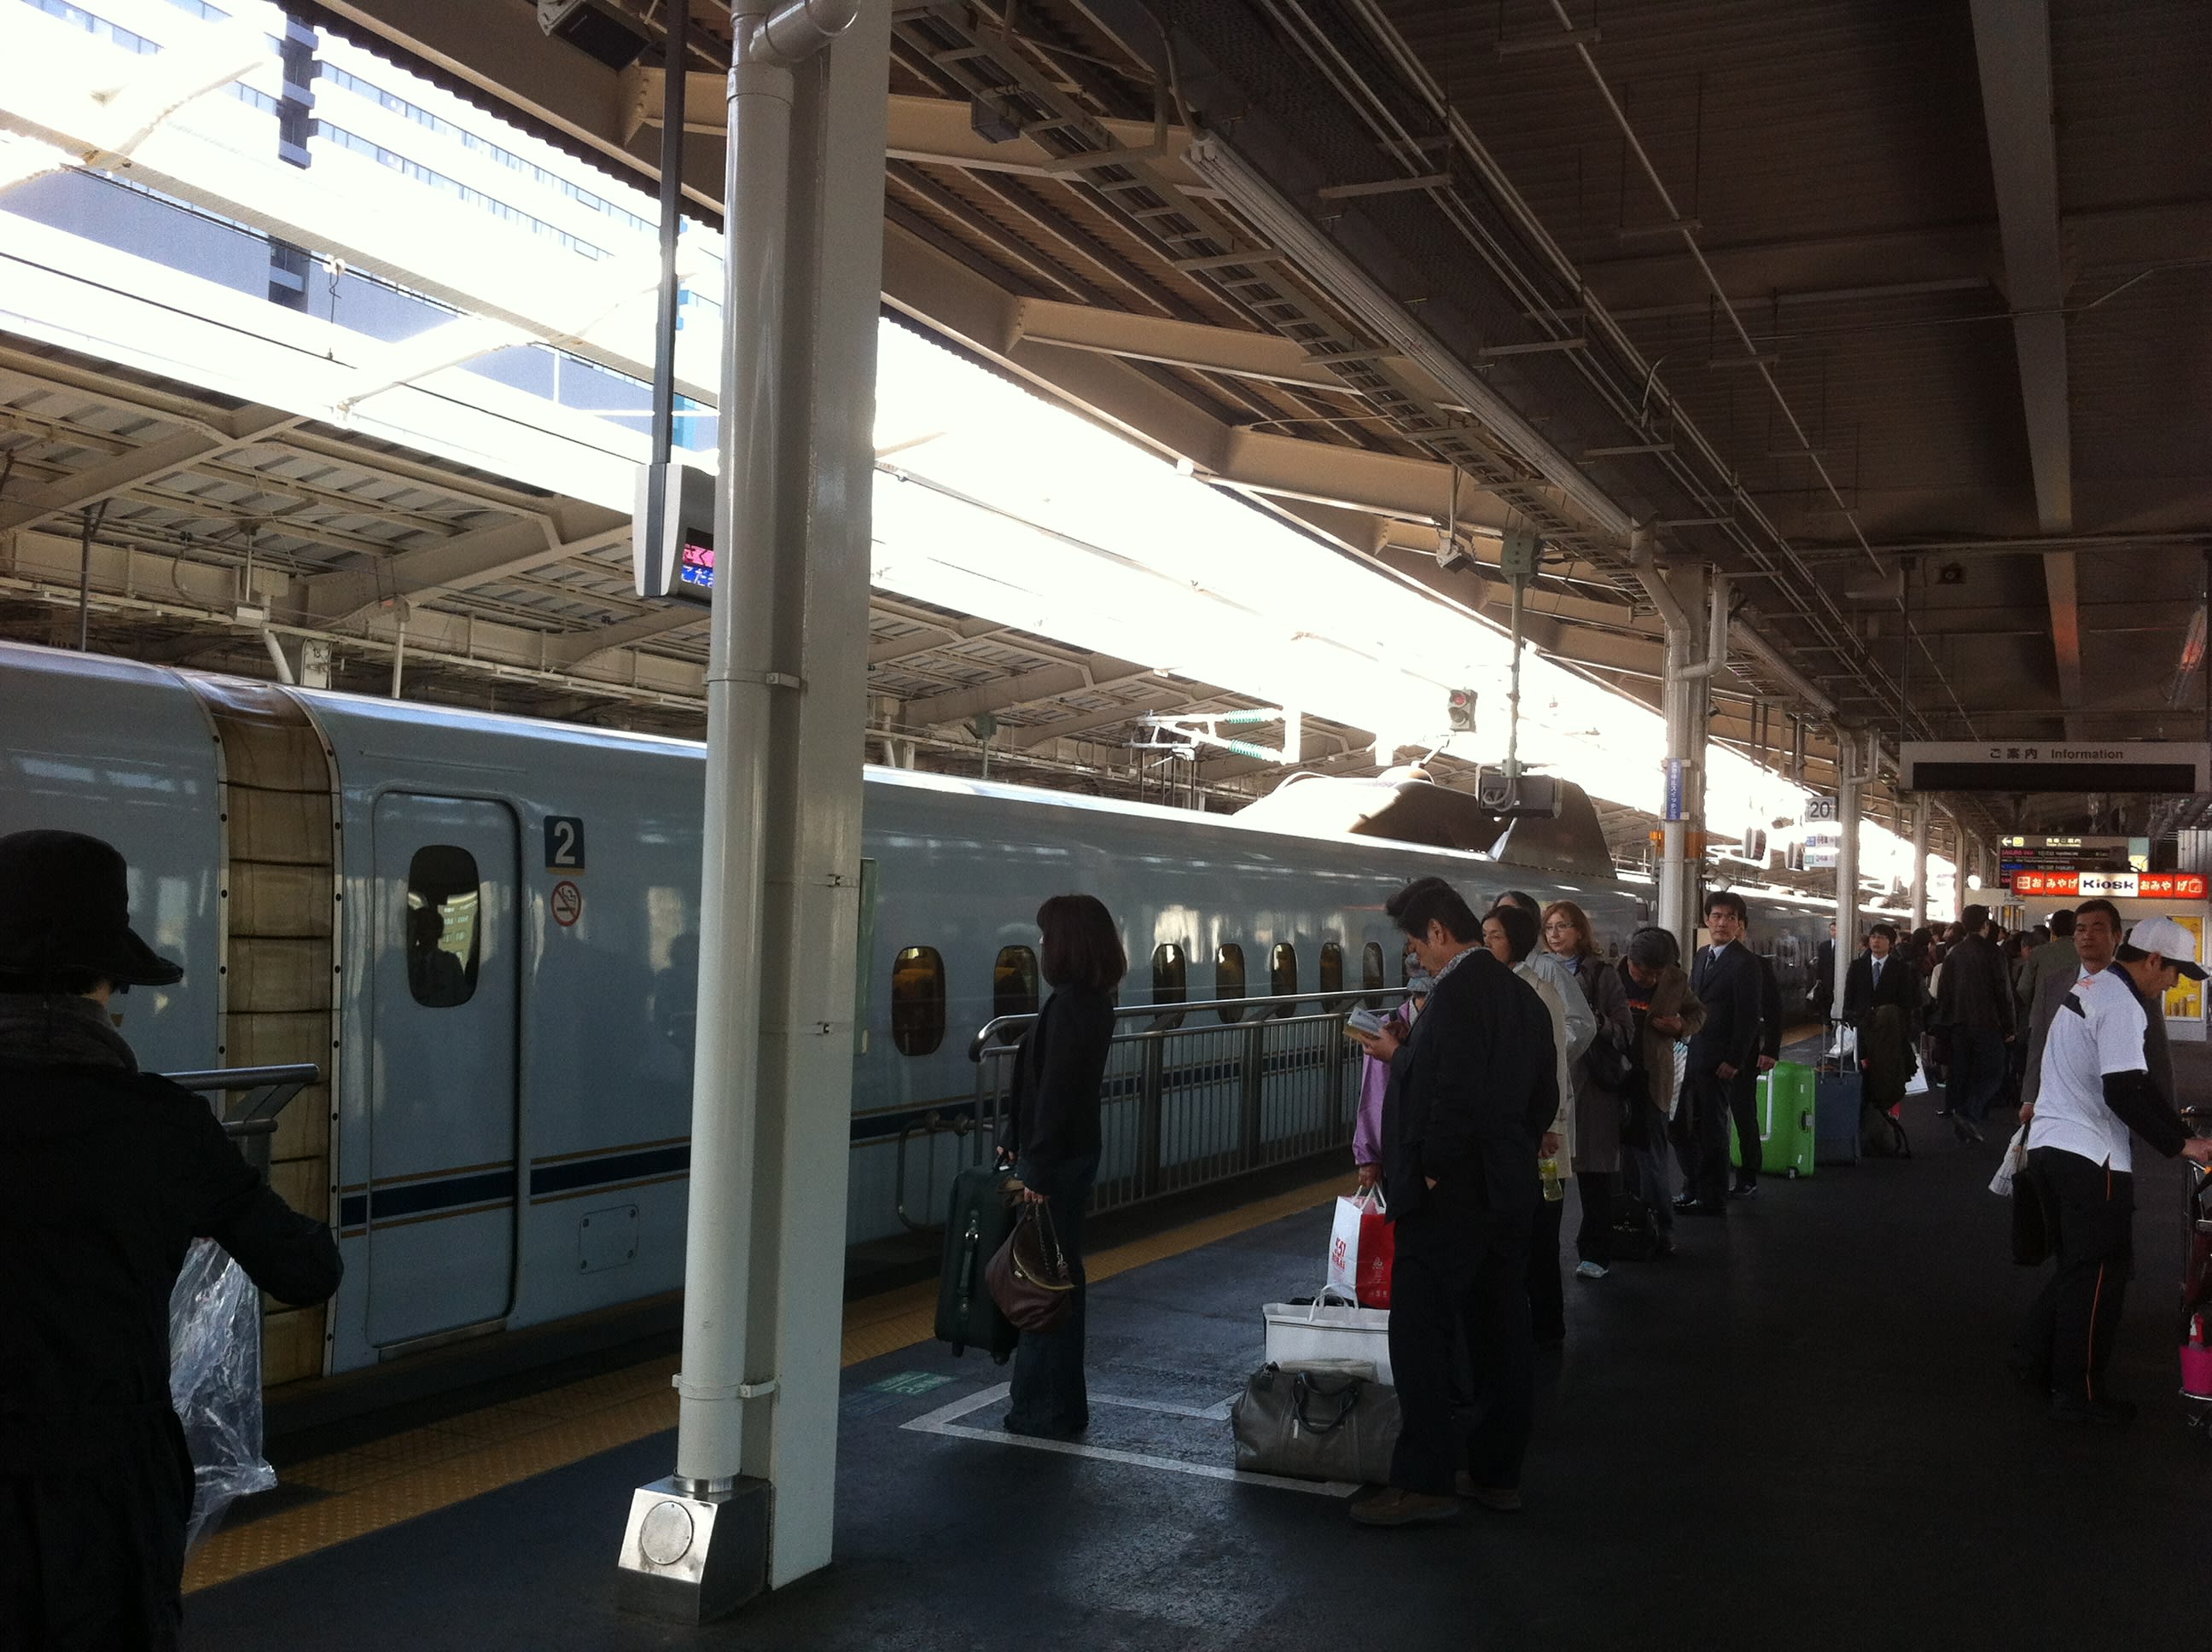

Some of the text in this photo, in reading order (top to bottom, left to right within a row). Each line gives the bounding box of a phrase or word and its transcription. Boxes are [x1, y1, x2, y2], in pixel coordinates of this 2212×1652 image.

[1989, 747, 2124, 759] ご案内 Information
[1809, 800, 1831, 818] 20
[554, 820, 576, 864] 2
[2032, 877, 2078, 888] おみやげ
[2082, 880, 2134, 890] Kiosk
[2139, 879, 2188, 892] おみやげ
